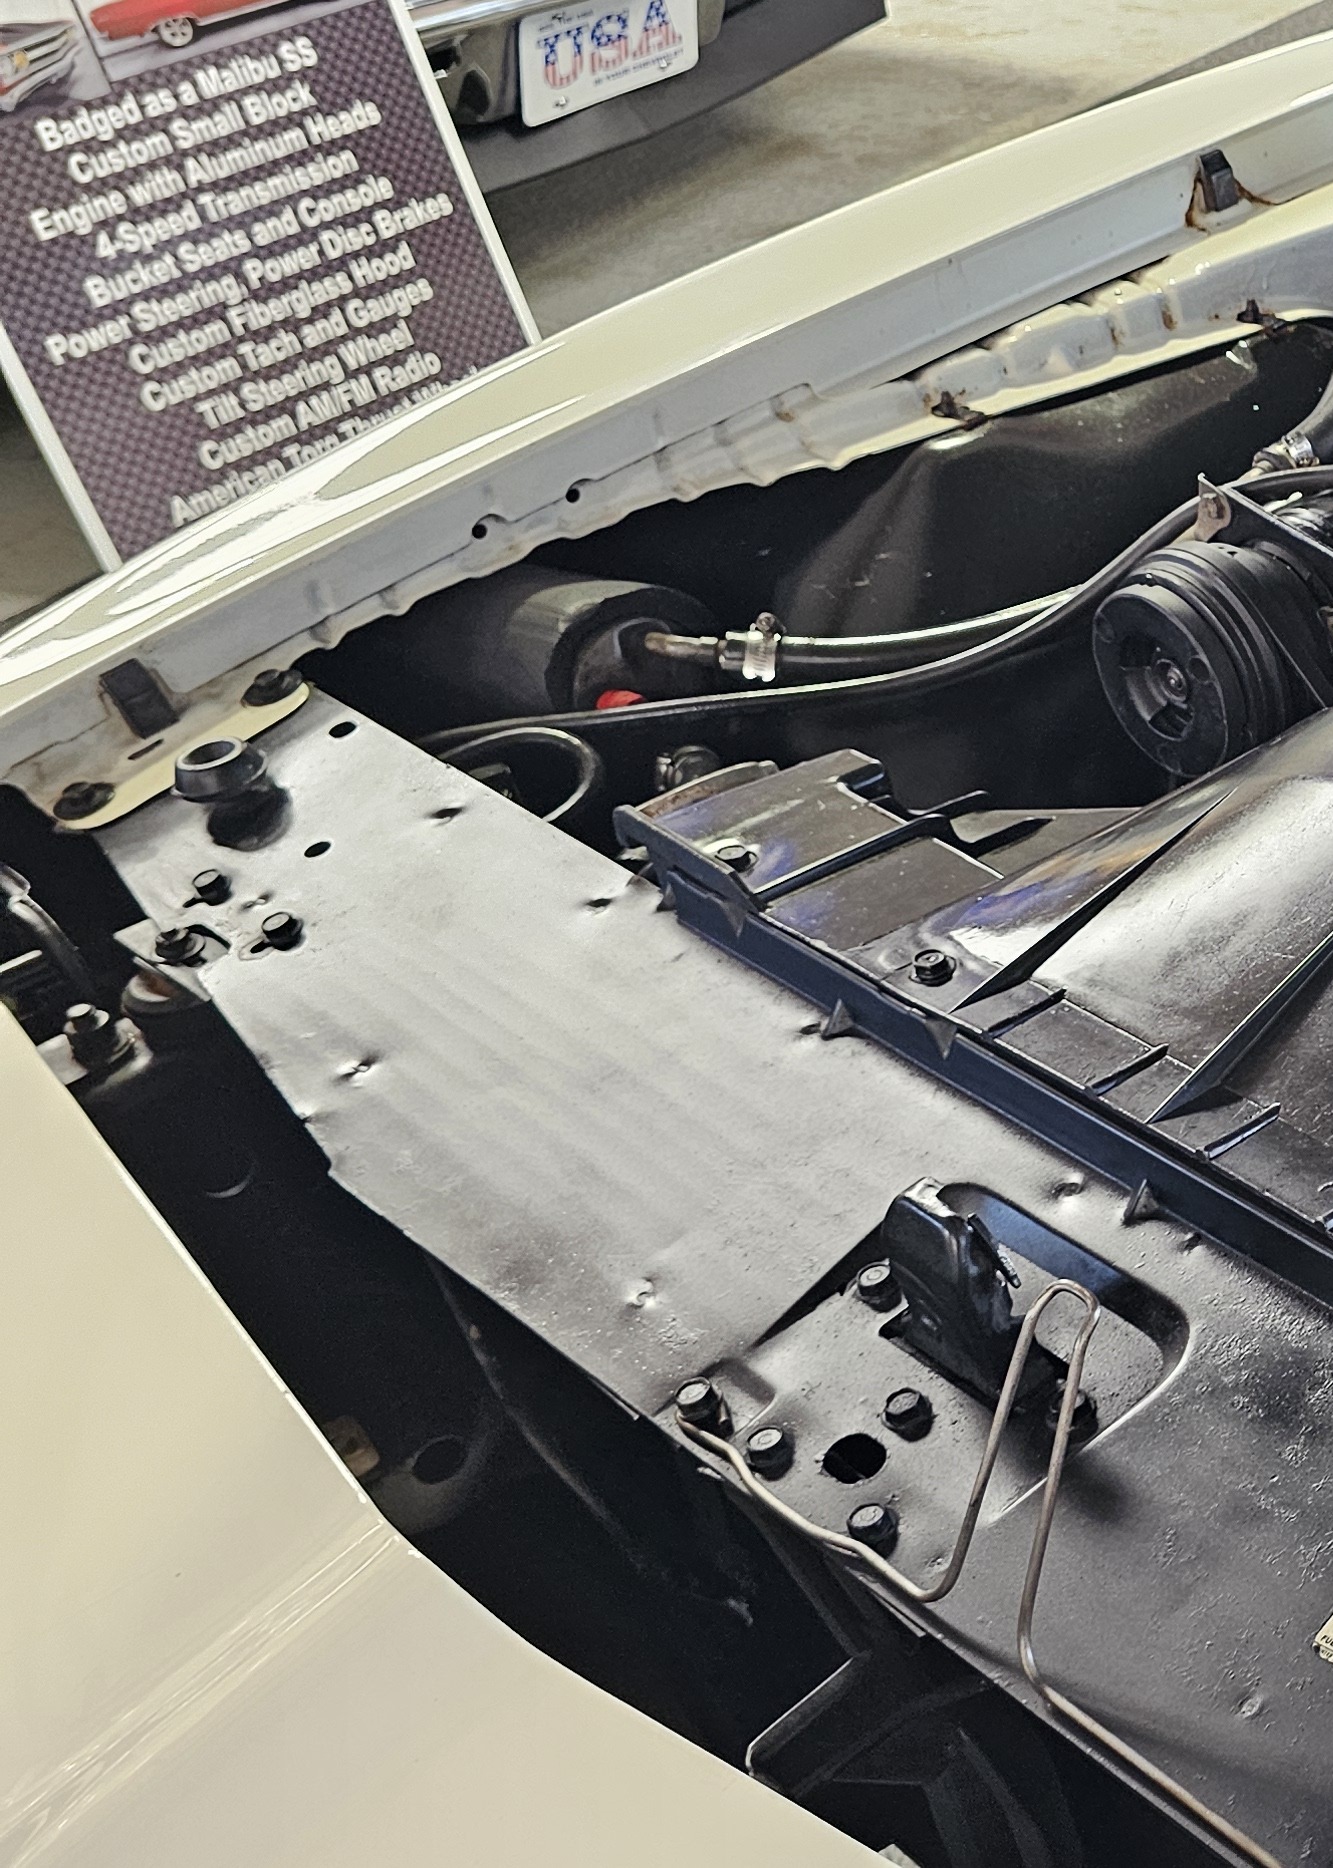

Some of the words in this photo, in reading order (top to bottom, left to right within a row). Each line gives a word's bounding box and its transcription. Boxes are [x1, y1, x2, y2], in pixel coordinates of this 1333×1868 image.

[36, 93, 141, 149] Badged
[142, 88, 176, 116] as
[177, 81, 199, 105] a
[195, 55, 280, 97] Malibu
[278, 37, 317, 71] SS
[537, 0, 683, 90] USA
[30, 191, 126, 239] Engine
[126, 167, 185, 205] with
[185, 128, 307, 186] Aluminum
[304, 101, 380, 143] Heads
[68, 133, 172, 182] Custom
[169, 102, 244, 148] Small
[242, 80, 315, 124] Block
[84, 253, 180, 306] Bucket
[177, 230, 250, 271] Seats
[251, 205, 299, 245] and
[298, 175, 392, 226] Console
[96, 201, 200, 258] 4-Speed
[198, 151, 357, 220] Transmission
[45, 315, 131, 364] Power
[131, 275, 247, 330] Steering,
[242, 242, 320, 288] Power
[319, 223, 375, 258] Disc
[373, 193, 452, 238] Brakes
[129, 320, 230, 373] Custom
[227, 272, 352, 334] Fiberglass
[349, 241, 414, 286] Hood
[141, 357, 241, 410] Custom
[237, 329, 301, 370] Tach
[301, 307, 348, 347] and
[346, 279, 432, 326] Gauges
[195, 392, 244, 428] Tilt
[240, 355, 343, 410] Steering
[339, 320, 413, 368] Wheel
[199, 415, 296, 468] Custom
[296, 376, 375, 429] AM/FM
[372, 351, 440, 394] Radio
[171, 460, 288, 525] American
